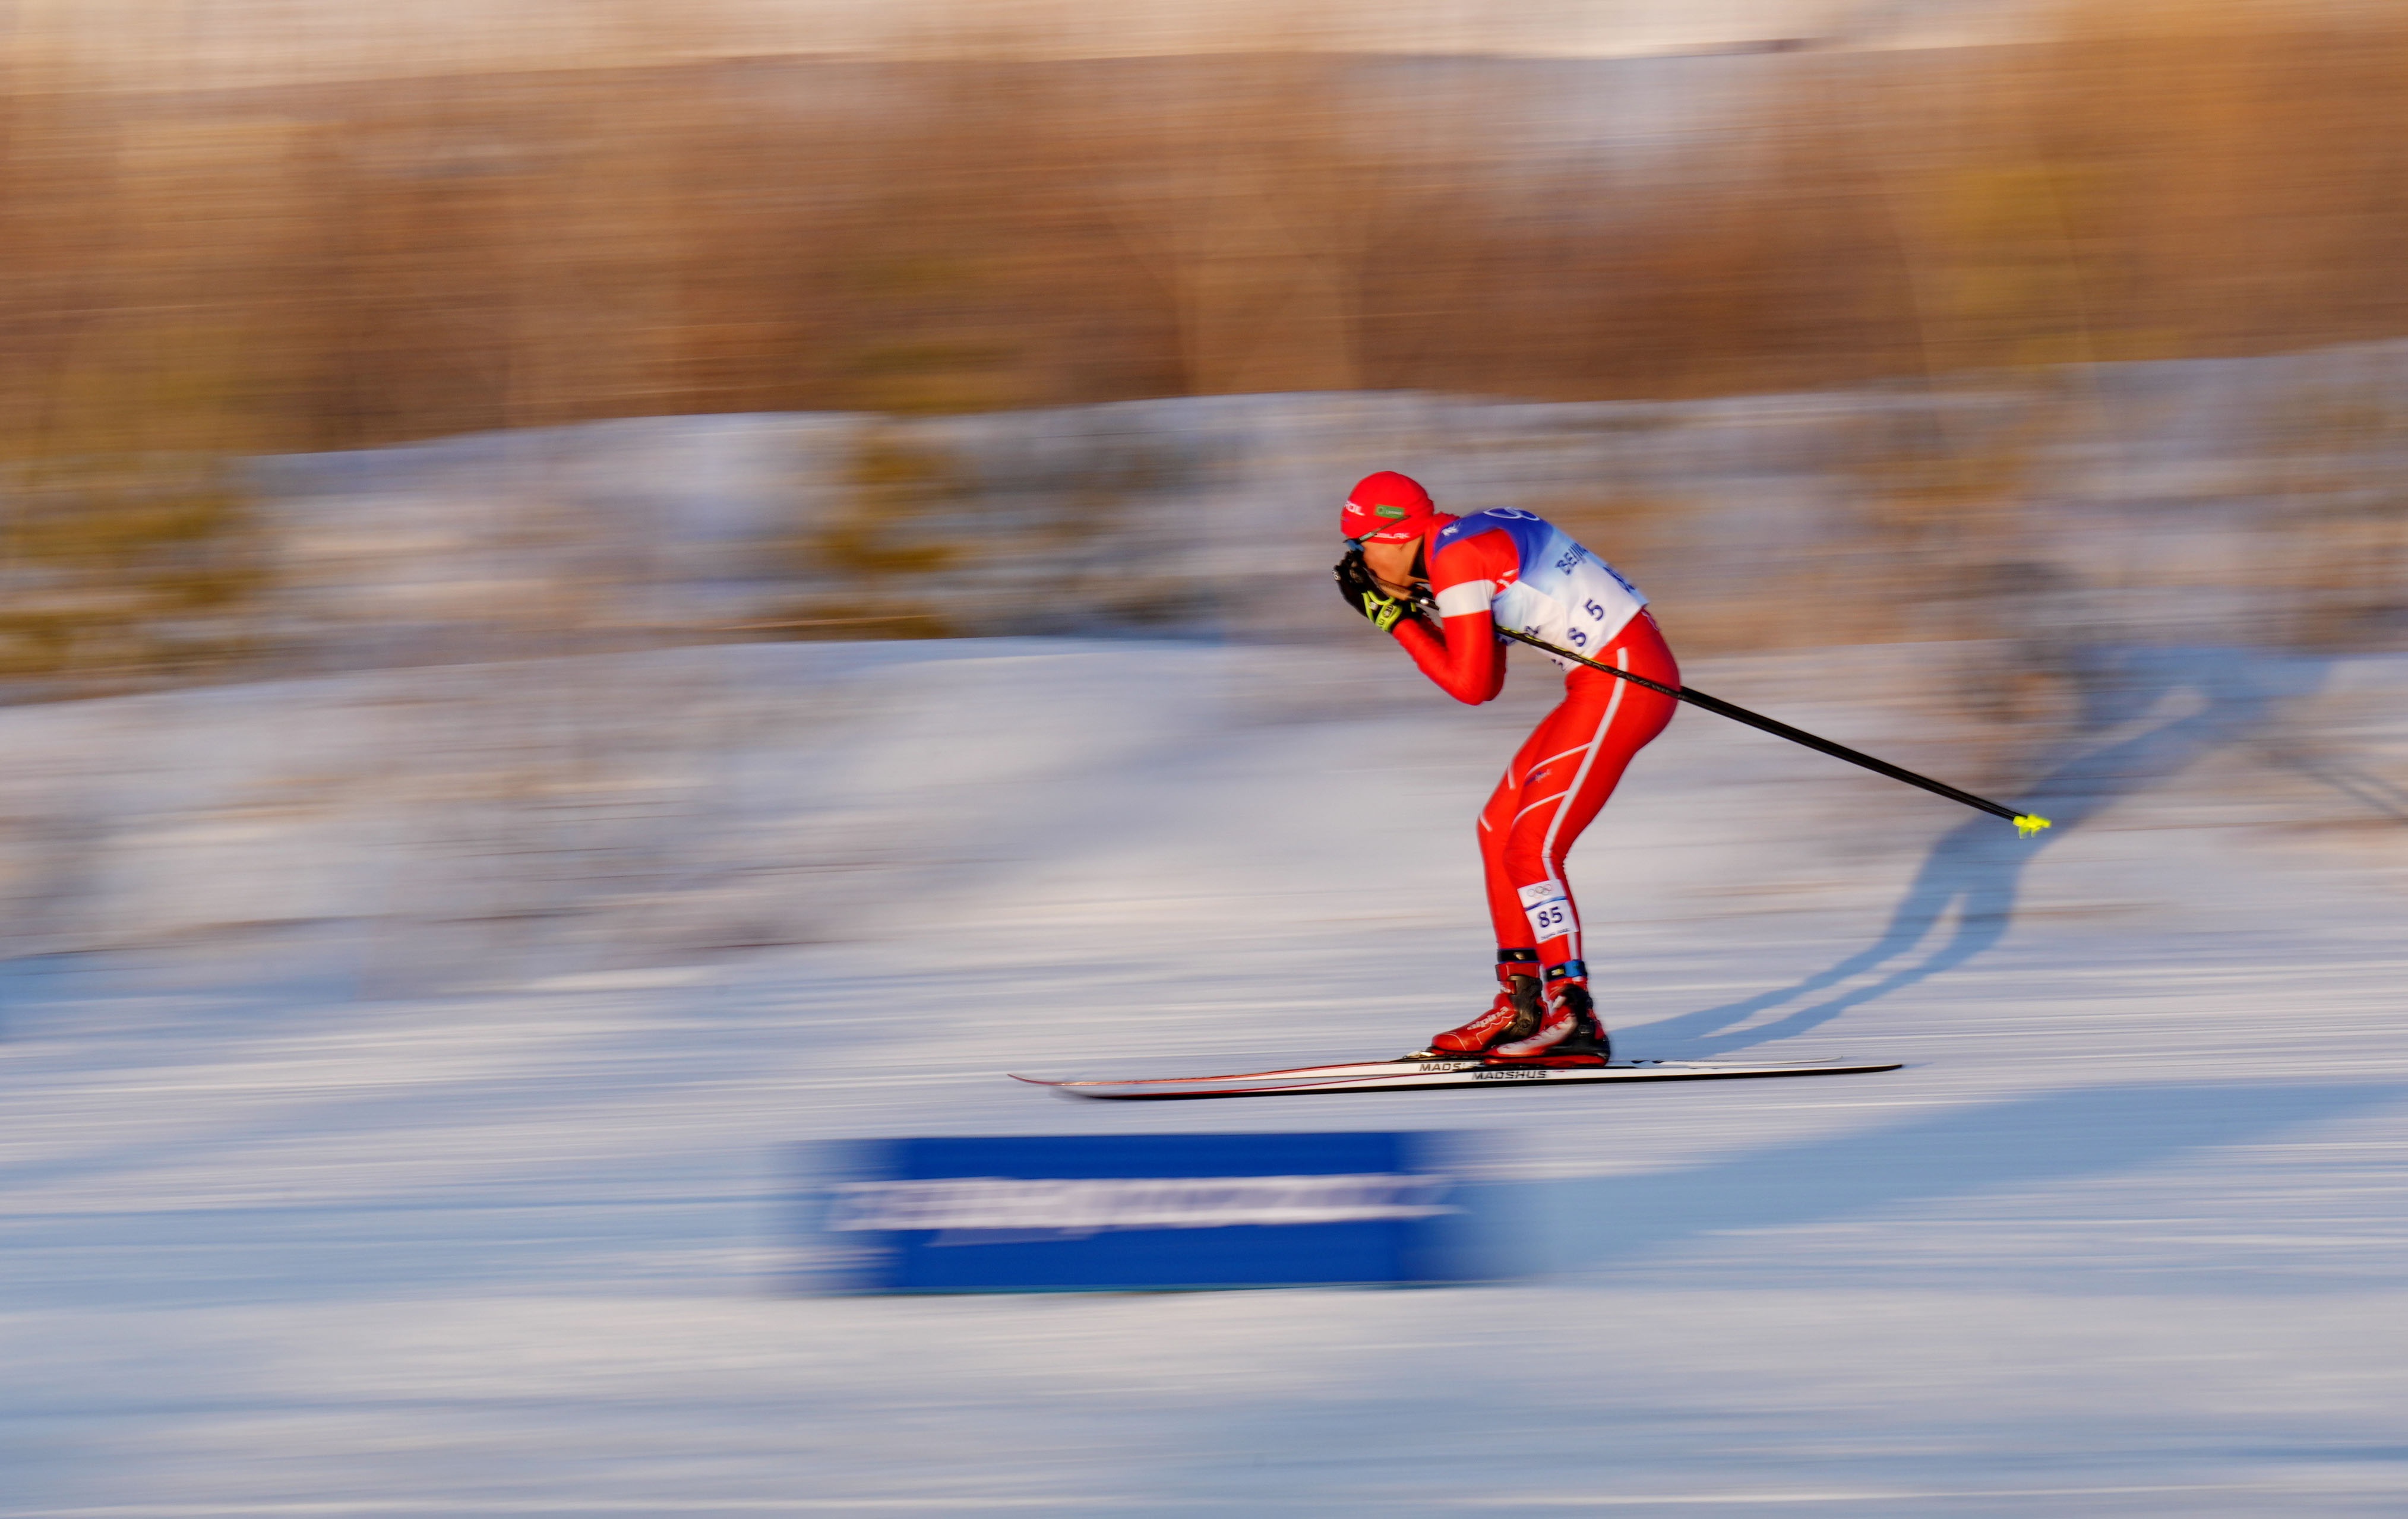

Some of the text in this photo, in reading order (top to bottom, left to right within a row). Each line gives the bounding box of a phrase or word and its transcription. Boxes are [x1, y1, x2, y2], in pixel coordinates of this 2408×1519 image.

[1538, 906, 1563, 928] 85
[1467, 1006, 1509, 1030] alpina
[1471, 1070, 1547, 1080] MADSHUS
